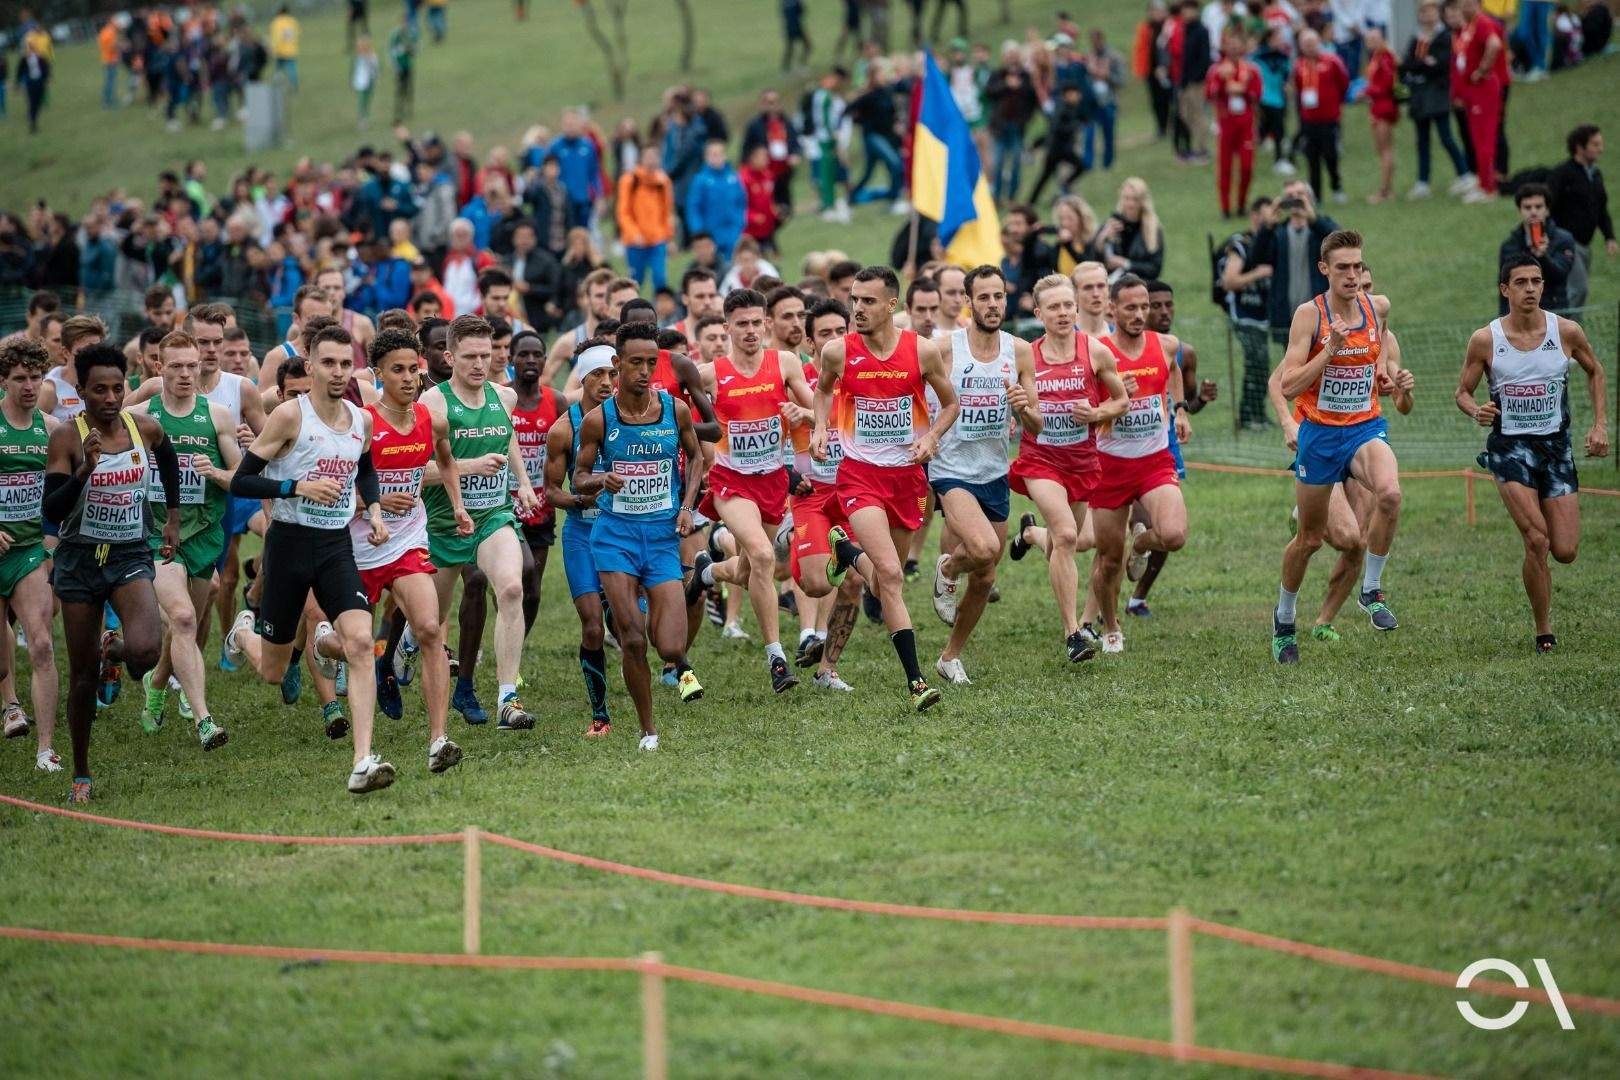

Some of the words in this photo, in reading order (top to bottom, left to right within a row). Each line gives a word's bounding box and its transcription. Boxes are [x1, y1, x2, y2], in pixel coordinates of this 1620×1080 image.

[1336, 346, 1369, 356] ederland
[857, 370, 908, 379] ESPAÑA
[1326, 368, 1363, 378] SPAR
[728, 384, 775, 397] ESPAÑA
[1036, 377, 1086, 392] DANMARK
[1323, 379, 1371, 395] FOPPEN
[1506, 386, 1545, 395] SPAR
[857, 400, 897, 410] SPAR
[960, 396, 998, 405] SPAR
[1128, 399, 1150, 409] PAR
[1039, 402, 1073, 412] SPAR
[858, 412, 911, 428] HASSAOUS
[962, 408, 1005, 423] HABZ
[730, 422, 768, 432] SPAR
[1044, 415, 1084, 430] IMONS
[455, 426, 508, 438] IRELAND
[168, 434, 208, 446] LAND
[733, 432, 779, 450] MAYO
[0, 446, 48, 454] RELAND
[382, 442, 426, 455] ESPAÑA
[520, 448, 538, 456] AR
[627, 443, 662, 456] ITALIA
[524, 460, 544, 474] AYA
[615, 464, 657, 475] SPAR
[0, 475, 35, 485] SPAR
[91, 467, 144, 486] GERMANY
[150, 468, 200, 486] TBIN
[377, 472, 411, 482] SPAR
[460, 472, 506, 491] BRADY
[629, 476, 669, 494] CRIPPA
[0, 486, 42, 504] LANDERS
[88, 492, 131, 504] SPAR
[86, 504, 140, 522] SIBHATU
[625, 504, 648, 512] LISBOA
[649, 502, 663, 510] 2019
[307, 516, 329, 525] LISBOA
[92, 530, 117, 538] LISBOA
